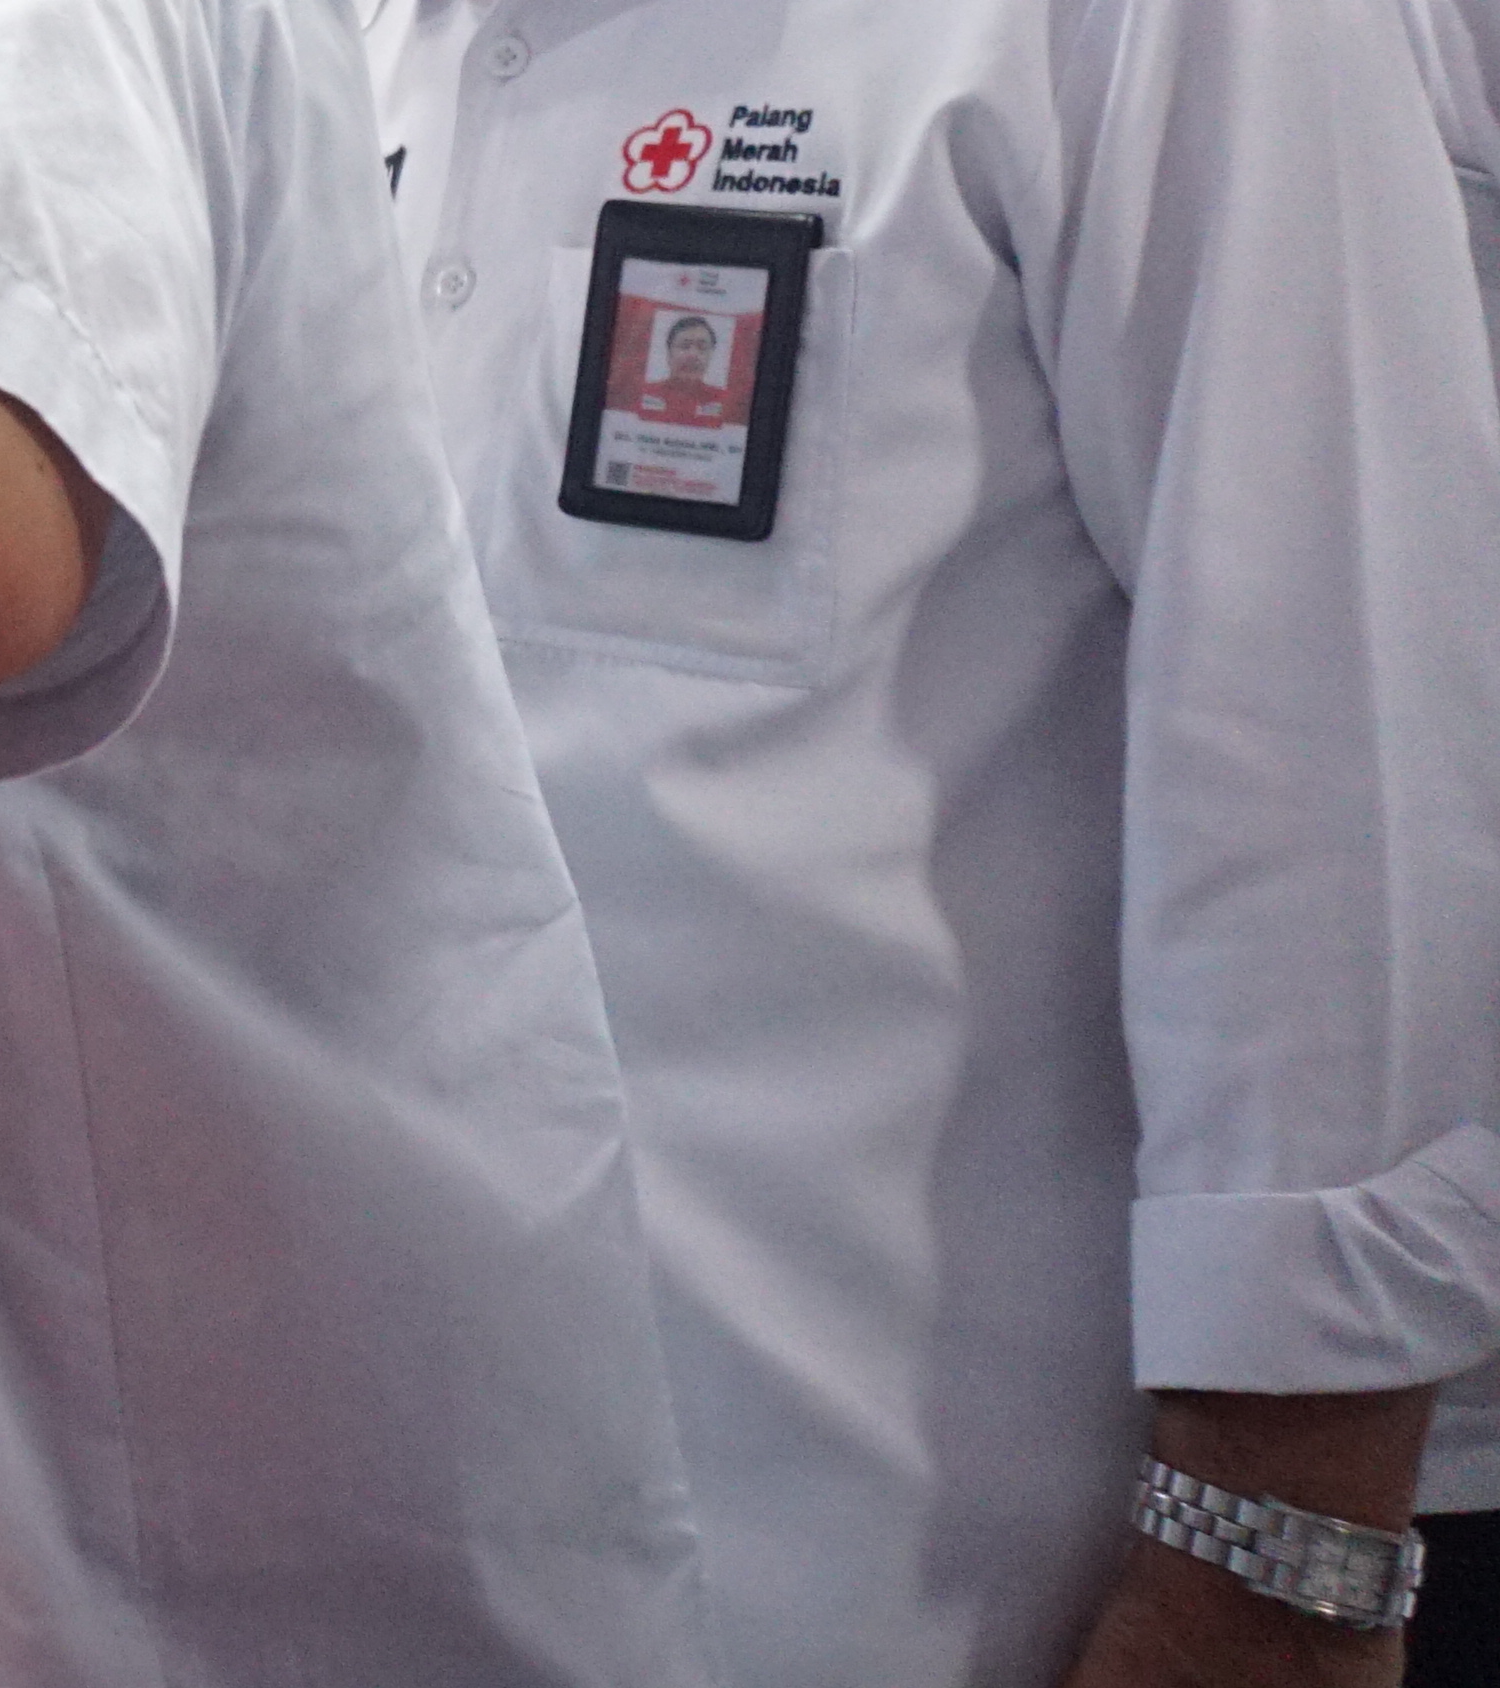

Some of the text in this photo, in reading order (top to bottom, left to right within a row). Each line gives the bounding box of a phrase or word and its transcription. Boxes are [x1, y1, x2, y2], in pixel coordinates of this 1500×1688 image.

[730, 104, 813, 133] Palang
[721, 138, 797, 163] Merah
[712, 170, 841, 197] Indonesia
